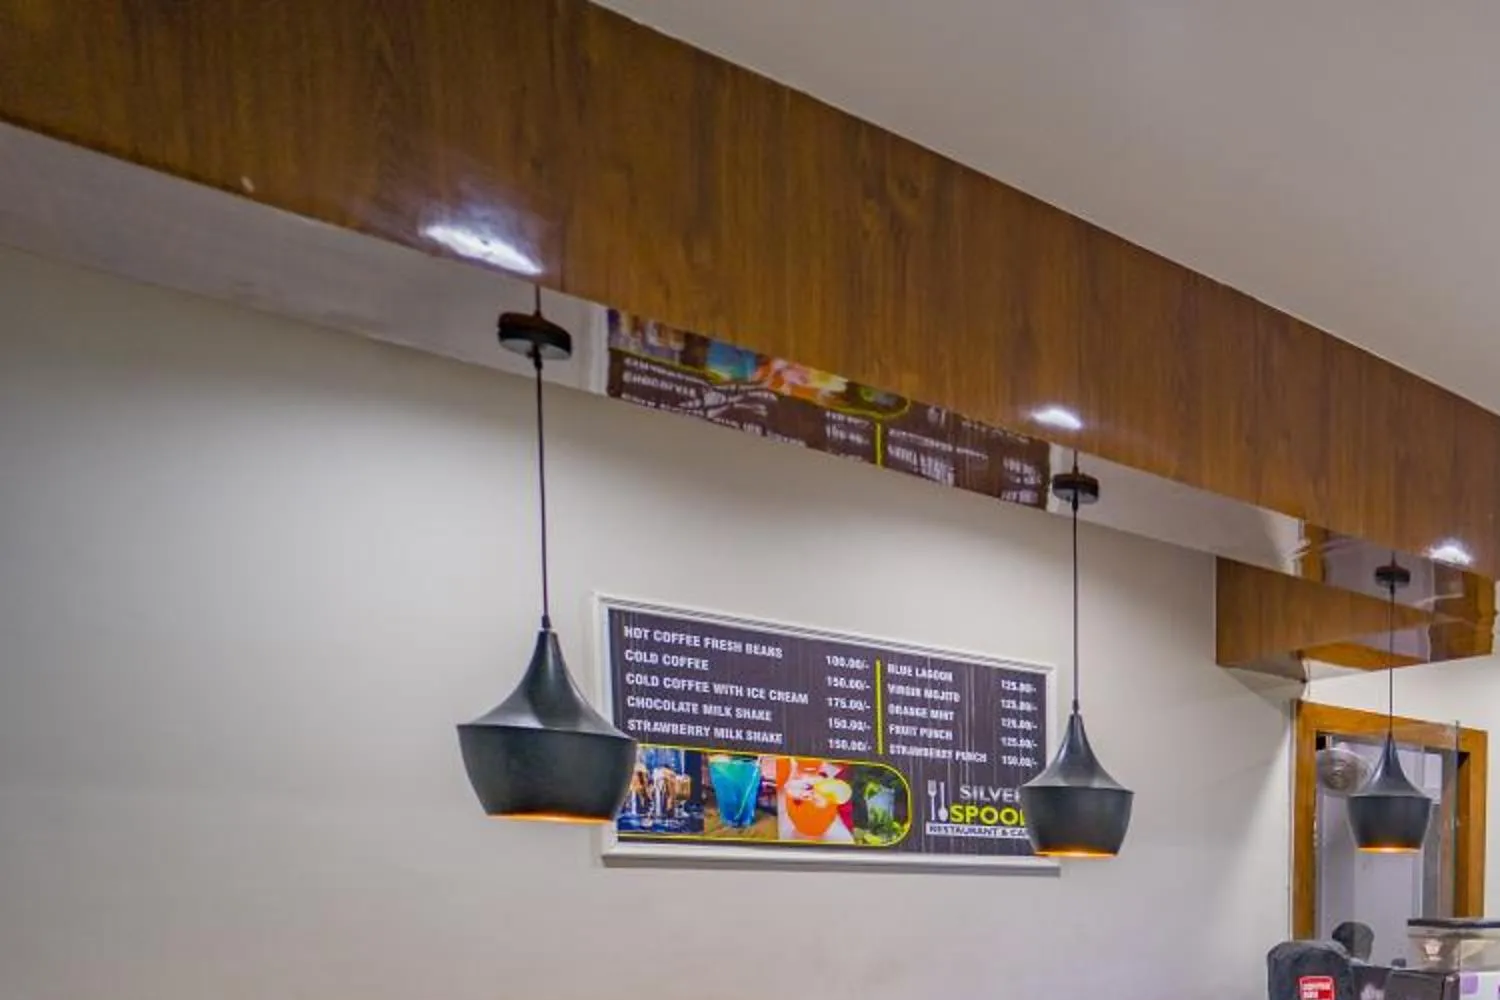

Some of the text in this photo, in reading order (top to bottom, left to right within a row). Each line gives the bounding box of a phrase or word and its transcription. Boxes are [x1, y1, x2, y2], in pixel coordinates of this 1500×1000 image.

[623, 625, 783, 659] HOT COFFEE FRESH BEANS
[625, 650, 709, 671] COLD COFFEE
[887, 663, 953, 682] BLUE LAGOON
[625, 673, 809, 705] COLD COFFEE WITH ICE CREAM
[887, 683, 961, 703] VIRGIN MOJITO
[627, 695, 772, 722] CHOCOLATE MILK SHAKE
[887, 703, 954, 721] ORANGE MINT
[627, 719, 783, 745] STRAWBERRY MILK SHAKE
[888, 723, 953, 741] FRUIT PUNCH
[955, 750, 987, 763] PUNCH
[959, 784, 1020, 803] SILVE
[949, 803, 1025, 826] SPOO
